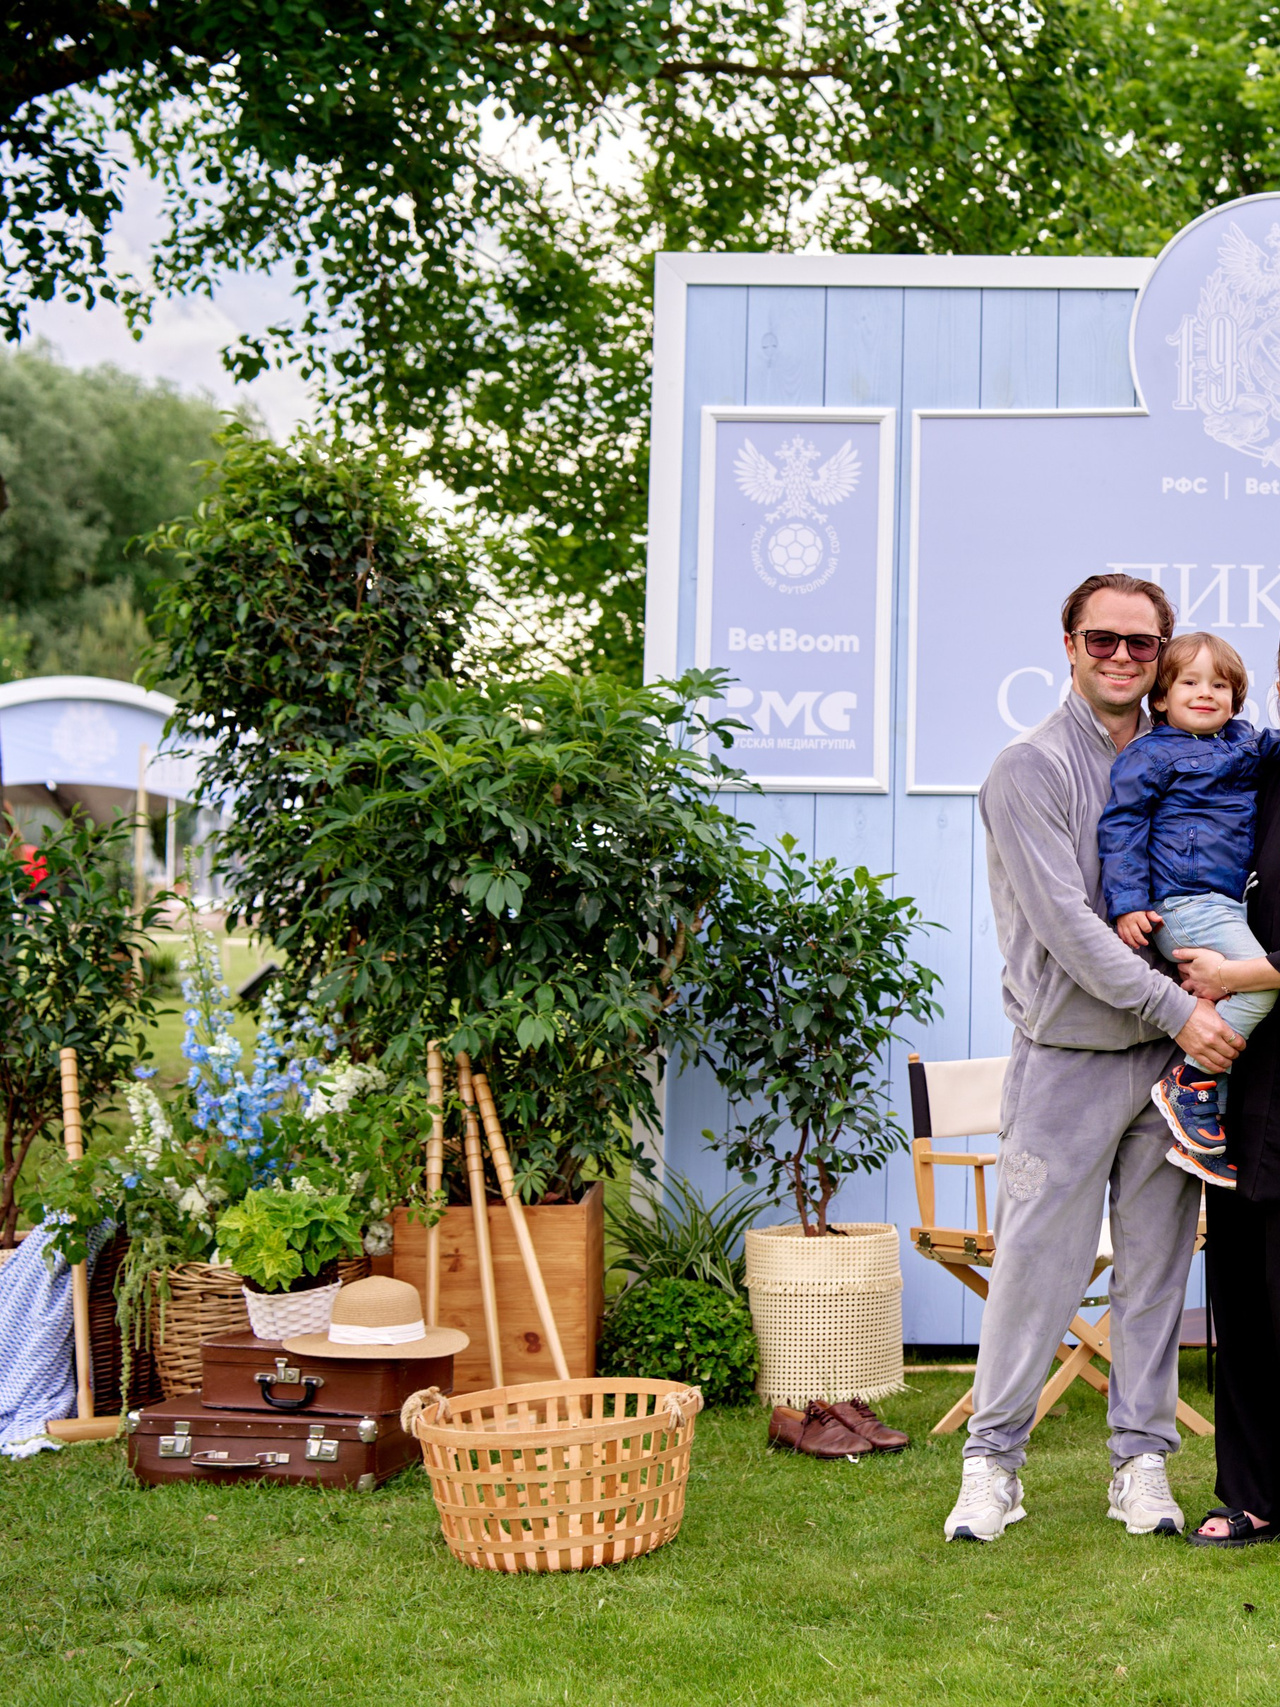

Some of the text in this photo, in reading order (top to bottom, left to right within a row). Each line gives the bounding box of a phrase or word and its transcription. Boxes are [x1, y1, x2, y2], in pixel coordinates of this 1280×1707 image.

[1165, 313, 1241, 413] 19
[1161, 477, 1208, 494] РФС
[751, 524, 841, 595] РОССИЙСКИЙ ФУТБОЛЬНЫЙ СОЮЗ
[728, 627, 860, 653] BetBoom
[997, 666, 1075, 734] С
[733, 738, 857, 751] УССКАЯ МЕДИАГРУППА
